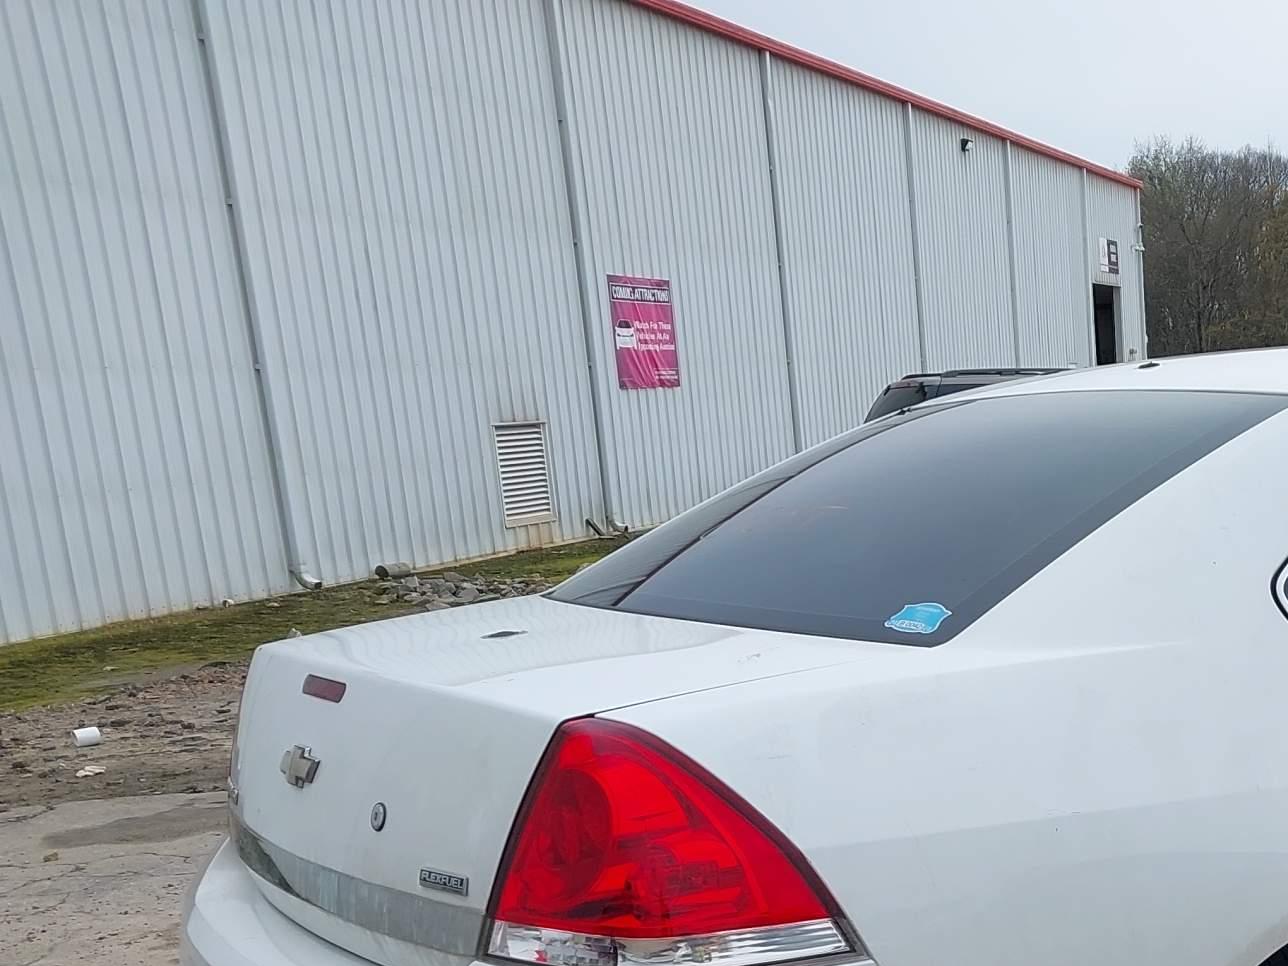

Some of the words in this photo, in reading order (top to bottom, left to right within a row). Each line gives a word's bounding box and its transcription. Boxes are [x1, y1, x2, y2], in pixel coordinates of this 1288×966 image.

[612, 285, 634, 299] COMING
[634, 288, 669, 302] ATTRACTIONS
[421, 870, 463, 889] FLEXFUEL
